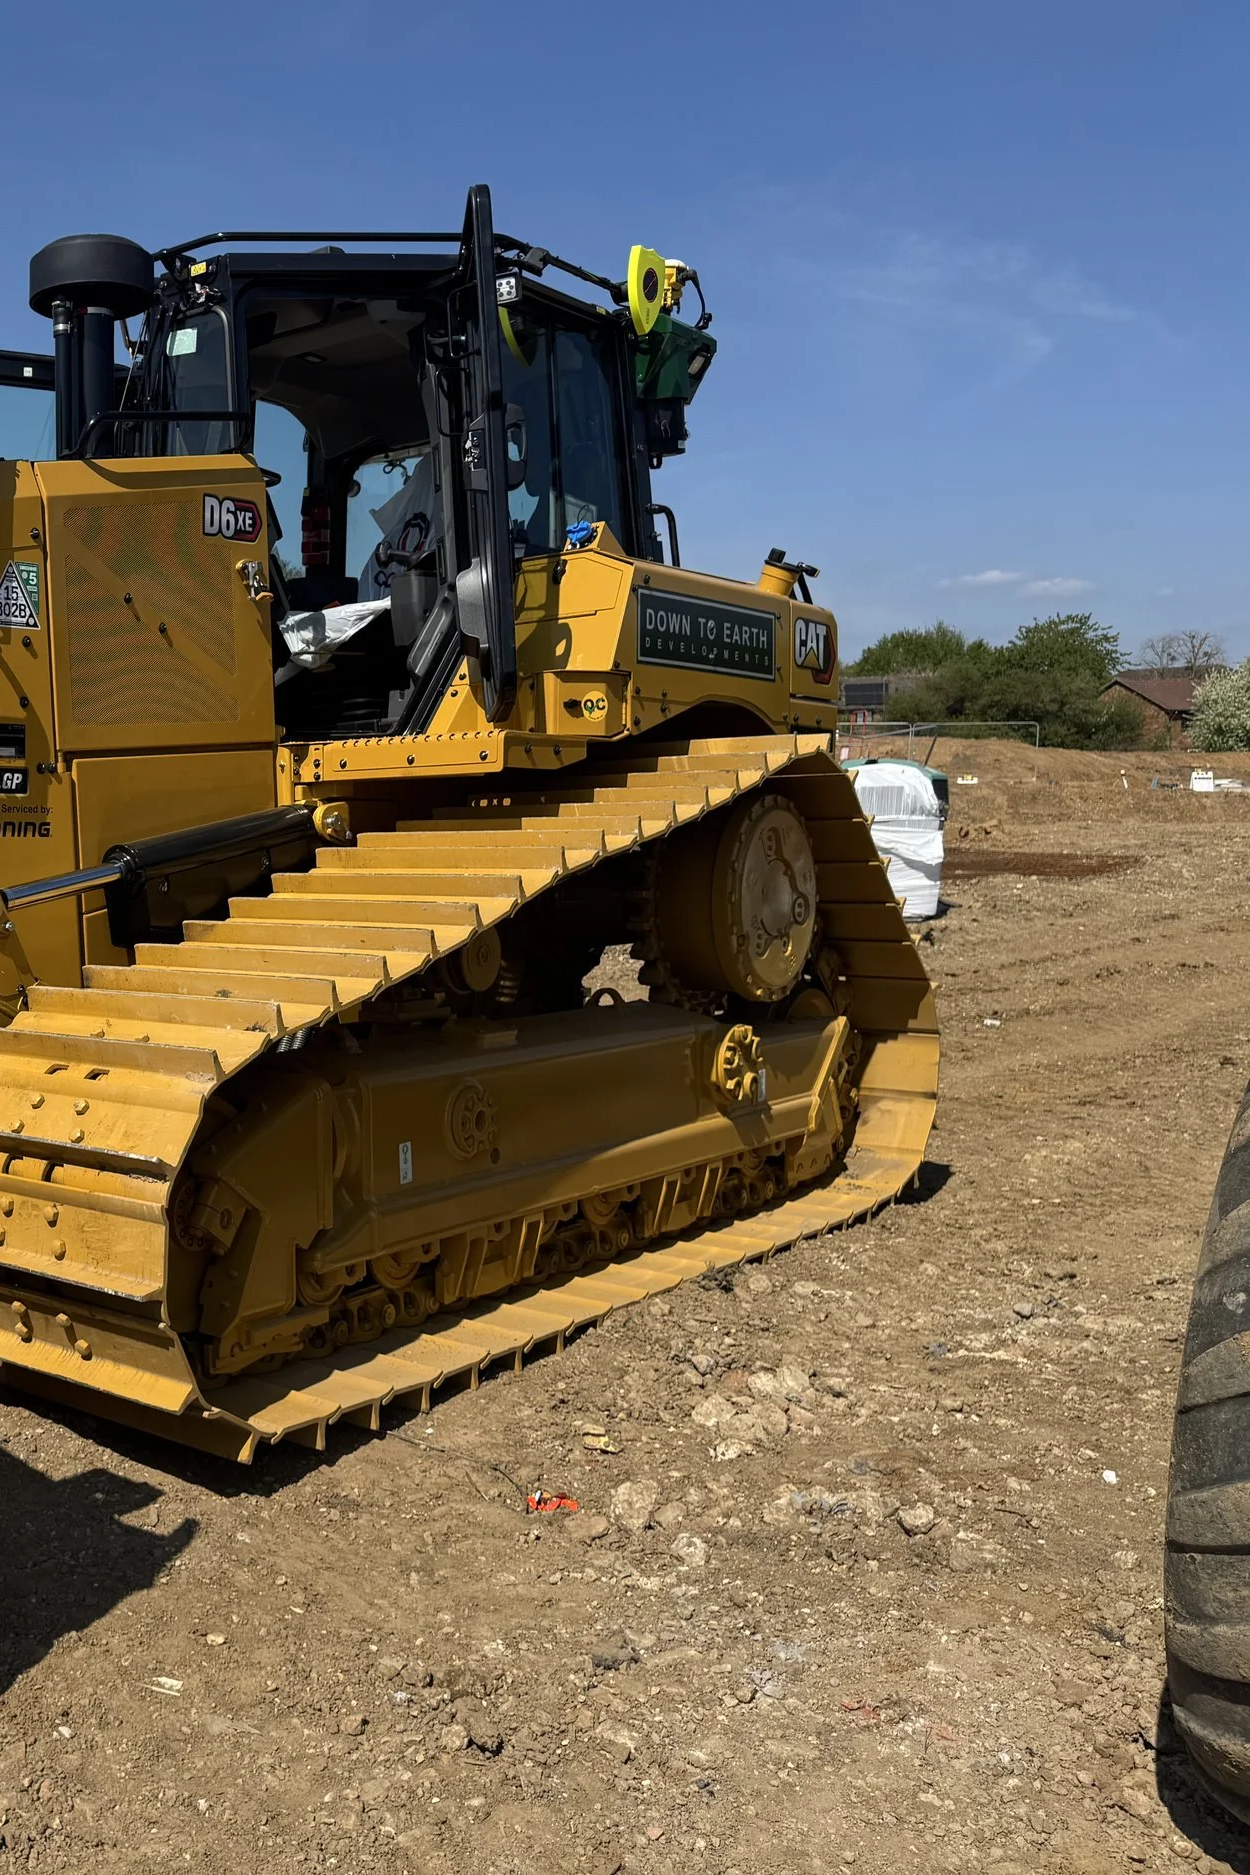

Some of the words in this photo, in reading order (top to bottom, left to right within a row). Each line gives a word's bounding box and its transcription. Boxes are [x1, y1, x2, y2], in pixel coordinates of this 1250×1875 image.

[29, 572, 37, 585] 5
[3, 585, 19, 602] 15
[646, 608, 690, 636] DOWN
[698, 618, 716, 640] TO
[723, 622, 768, 649] EARTH
[646, 637, 769, 666] DEVELOPMENTS
[795, 618, 827, 671] CAT
[1, 804, 38, 814] Serviced
[40, 804, 53, 816] by:
